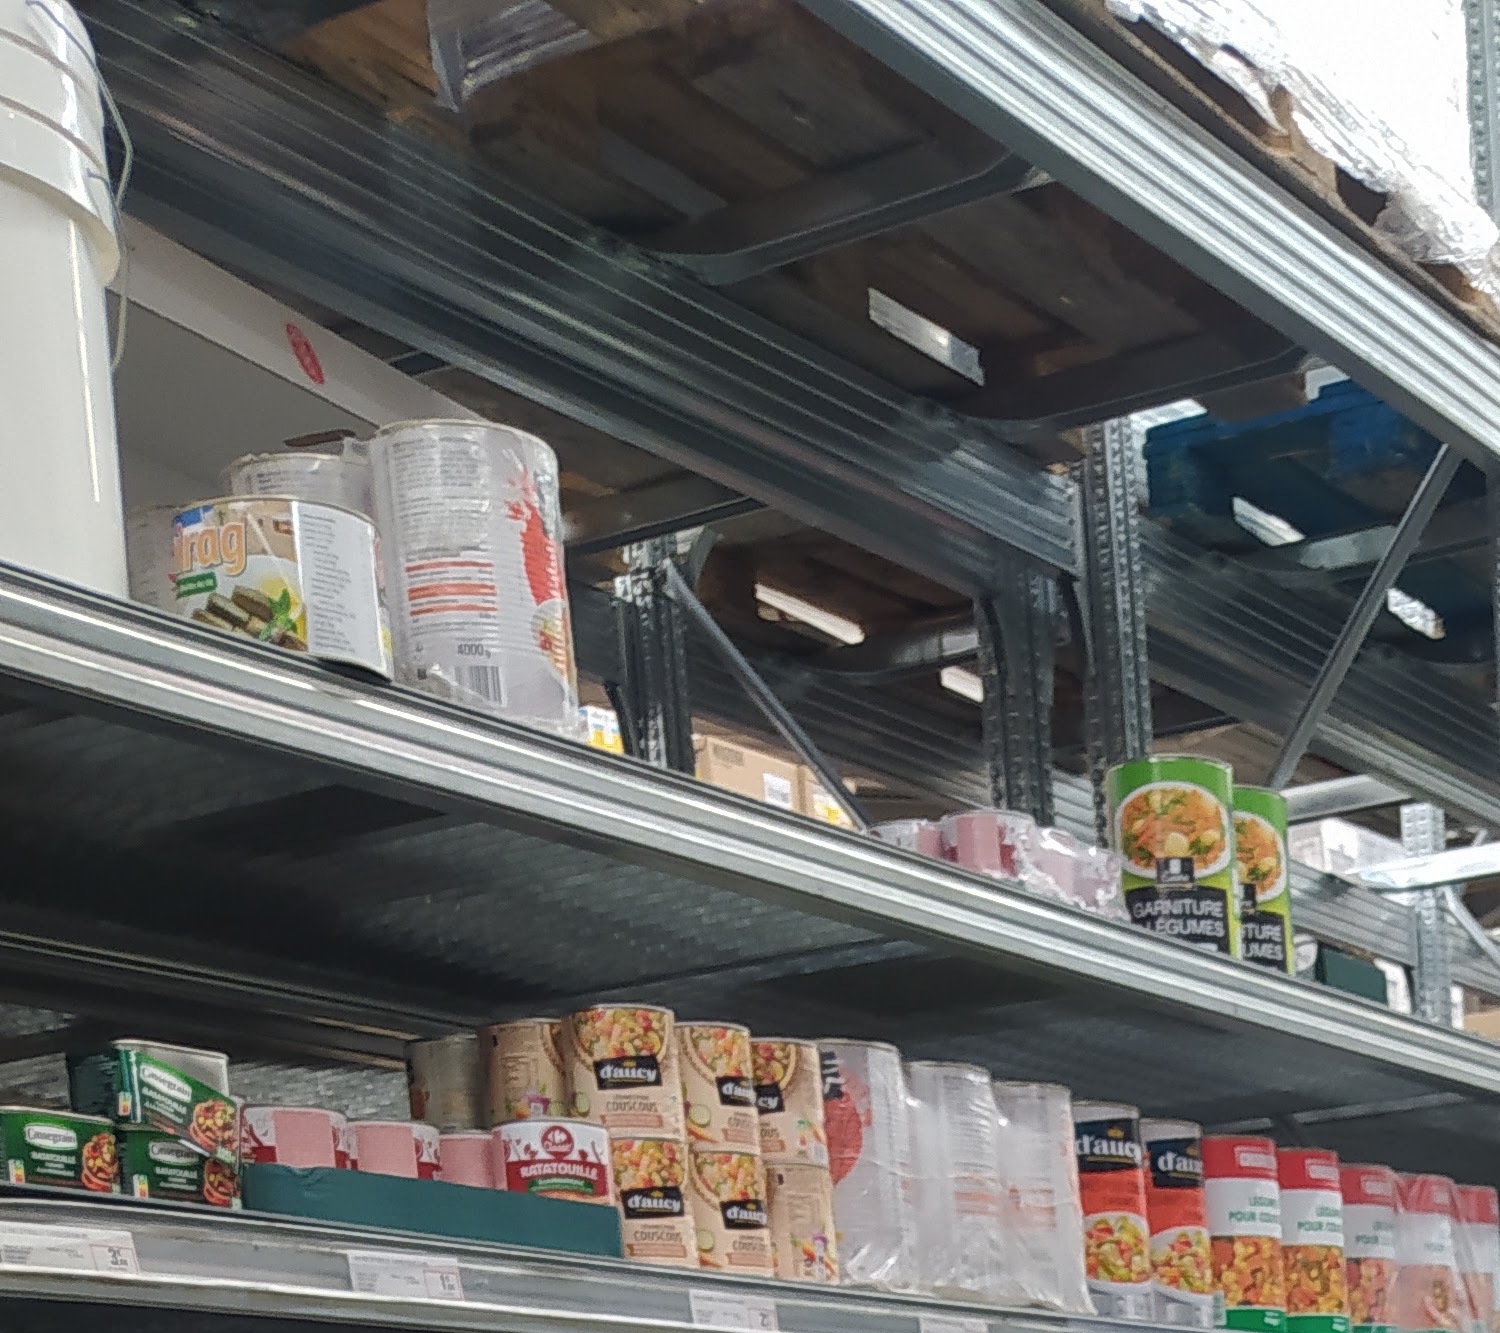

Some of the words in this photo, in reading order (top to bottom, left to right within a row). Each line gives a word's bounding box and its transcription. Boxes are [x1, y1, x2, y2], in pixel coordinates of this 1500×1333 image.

[600, 1064, 657, 1083] d'aucy
[520, 1162, 599, 1181] RATATOUILLE
[628, 1194, 682, 1213] d'aucy
